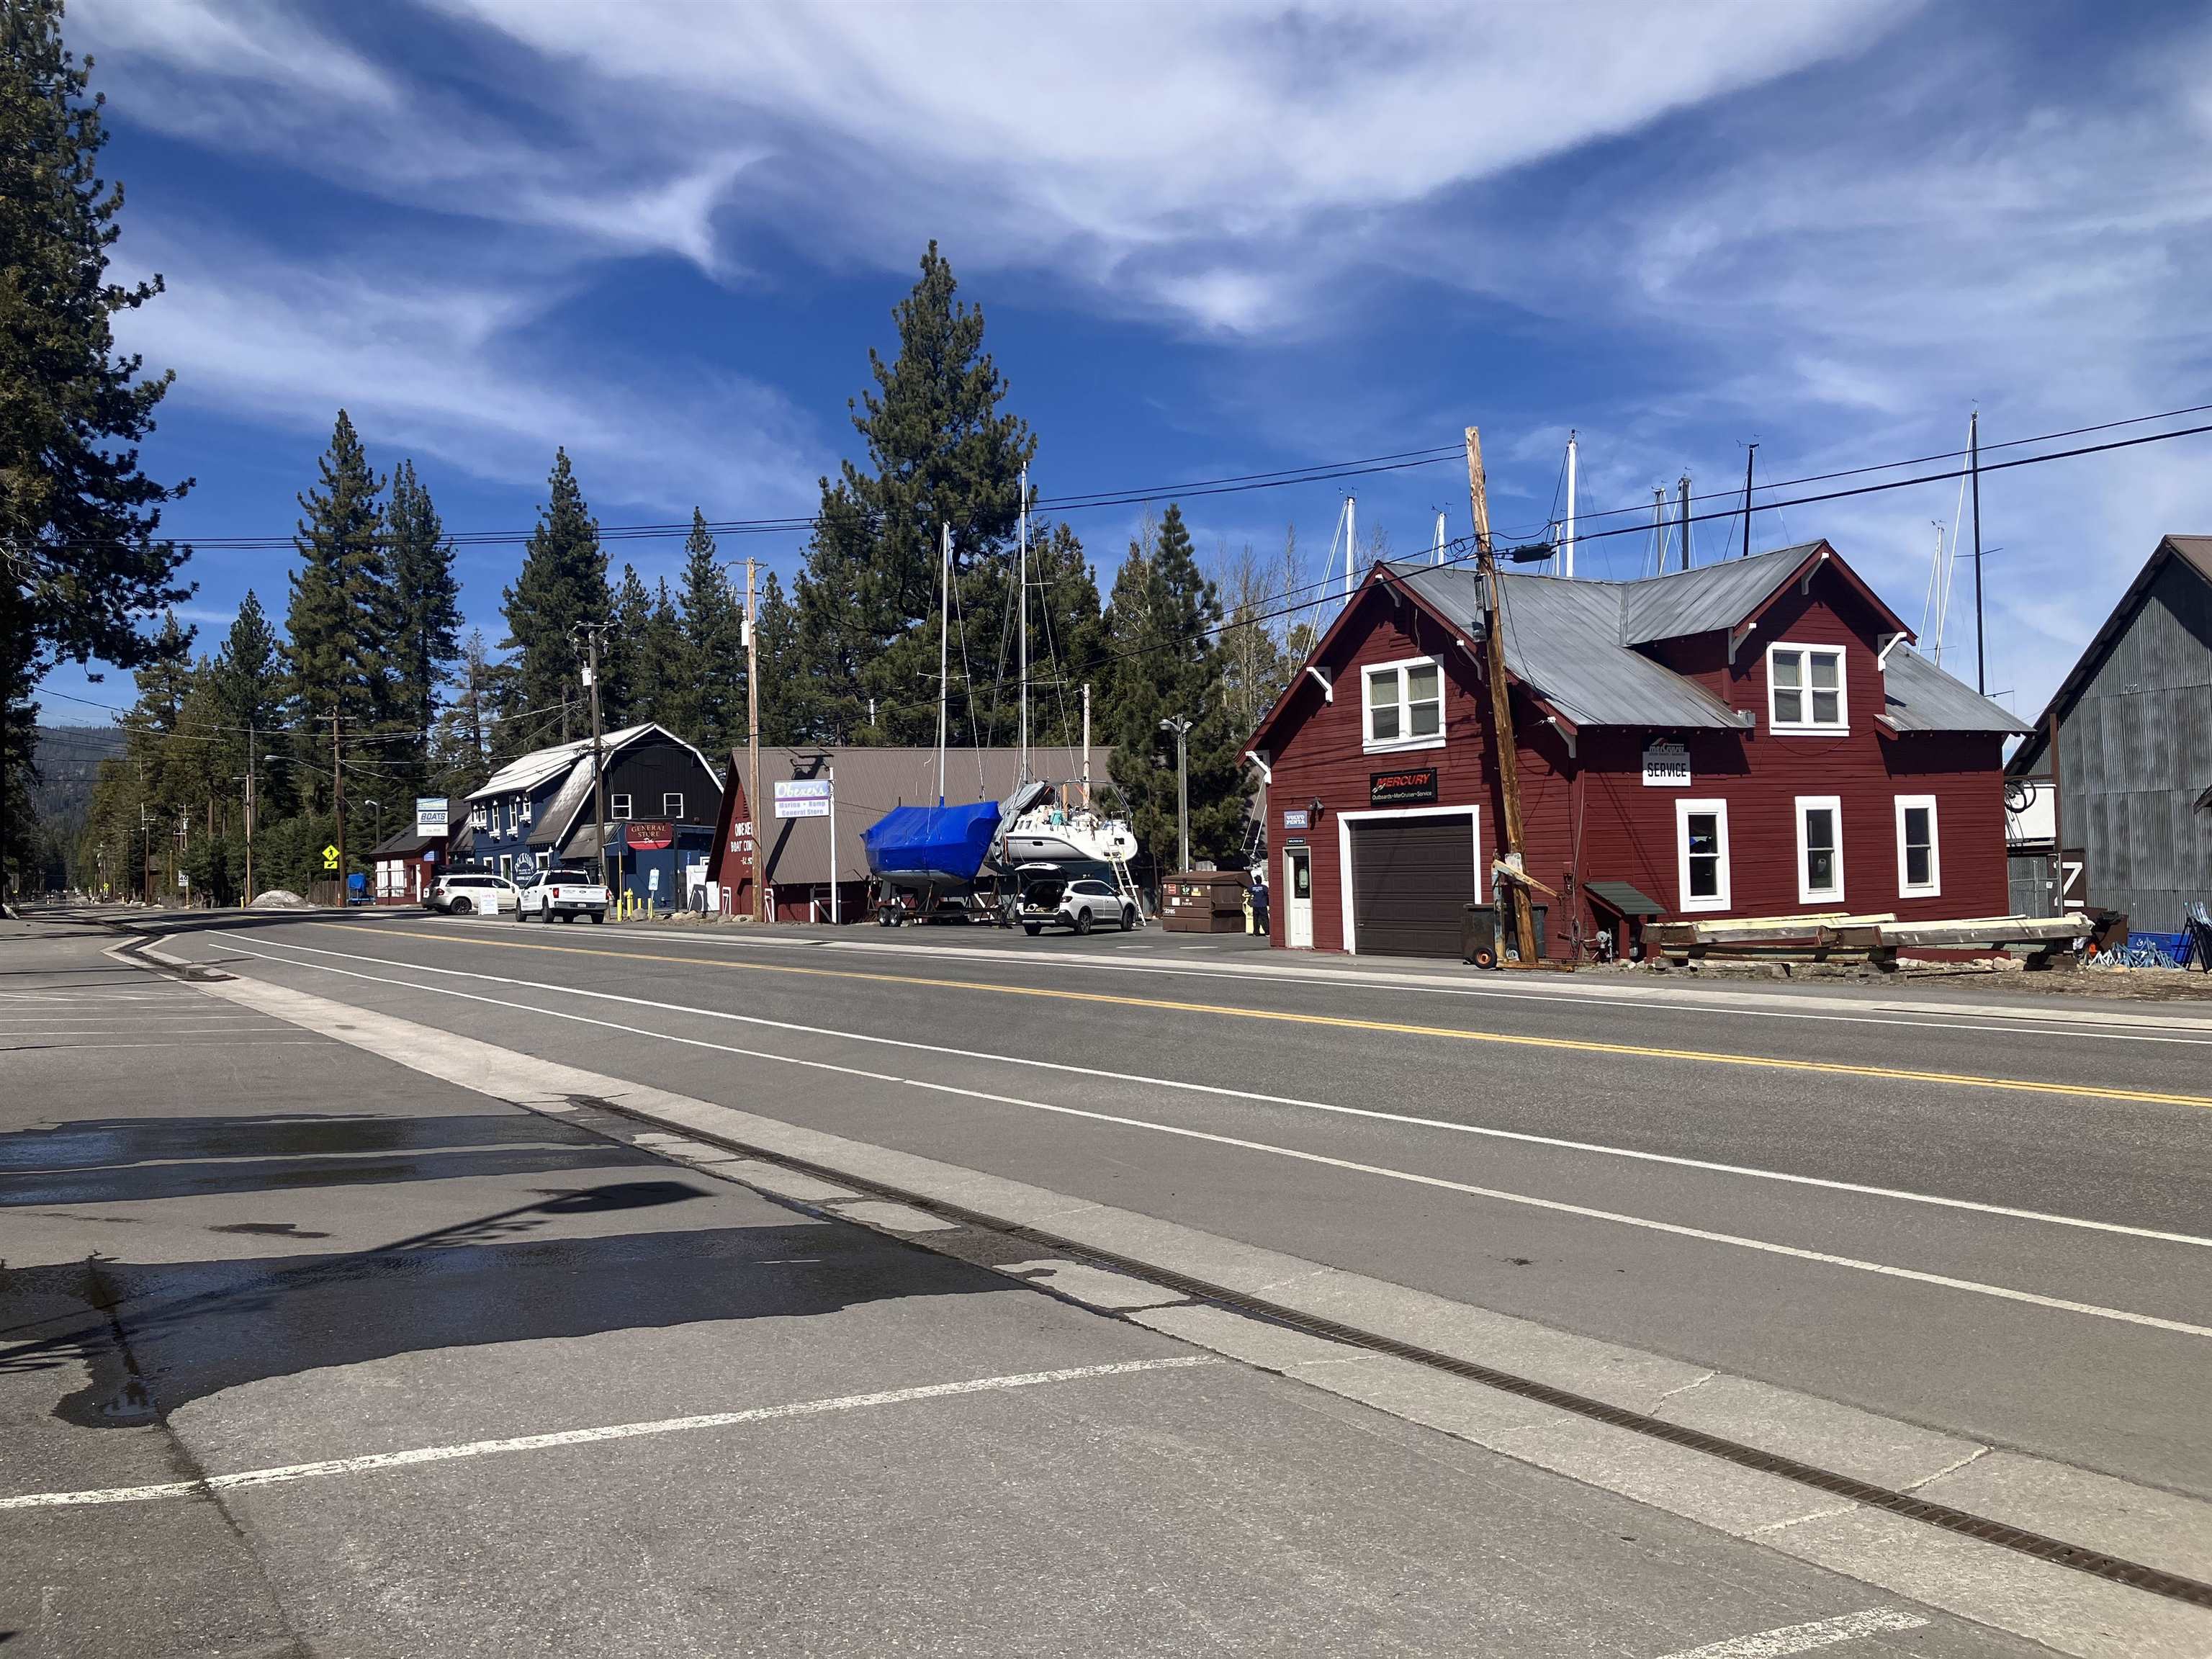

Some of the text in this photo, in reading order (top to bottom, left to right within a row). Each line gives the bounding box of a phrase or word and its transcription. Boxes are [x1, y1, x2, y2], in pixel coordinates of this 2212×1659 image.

[1647, 763, 1686, 777] SERVICE
[1377, 773, 1431, 788] MERCURY
[734, 822, 752, 837] OBEXE
[731, 840, 752, 853] BOAT COM
